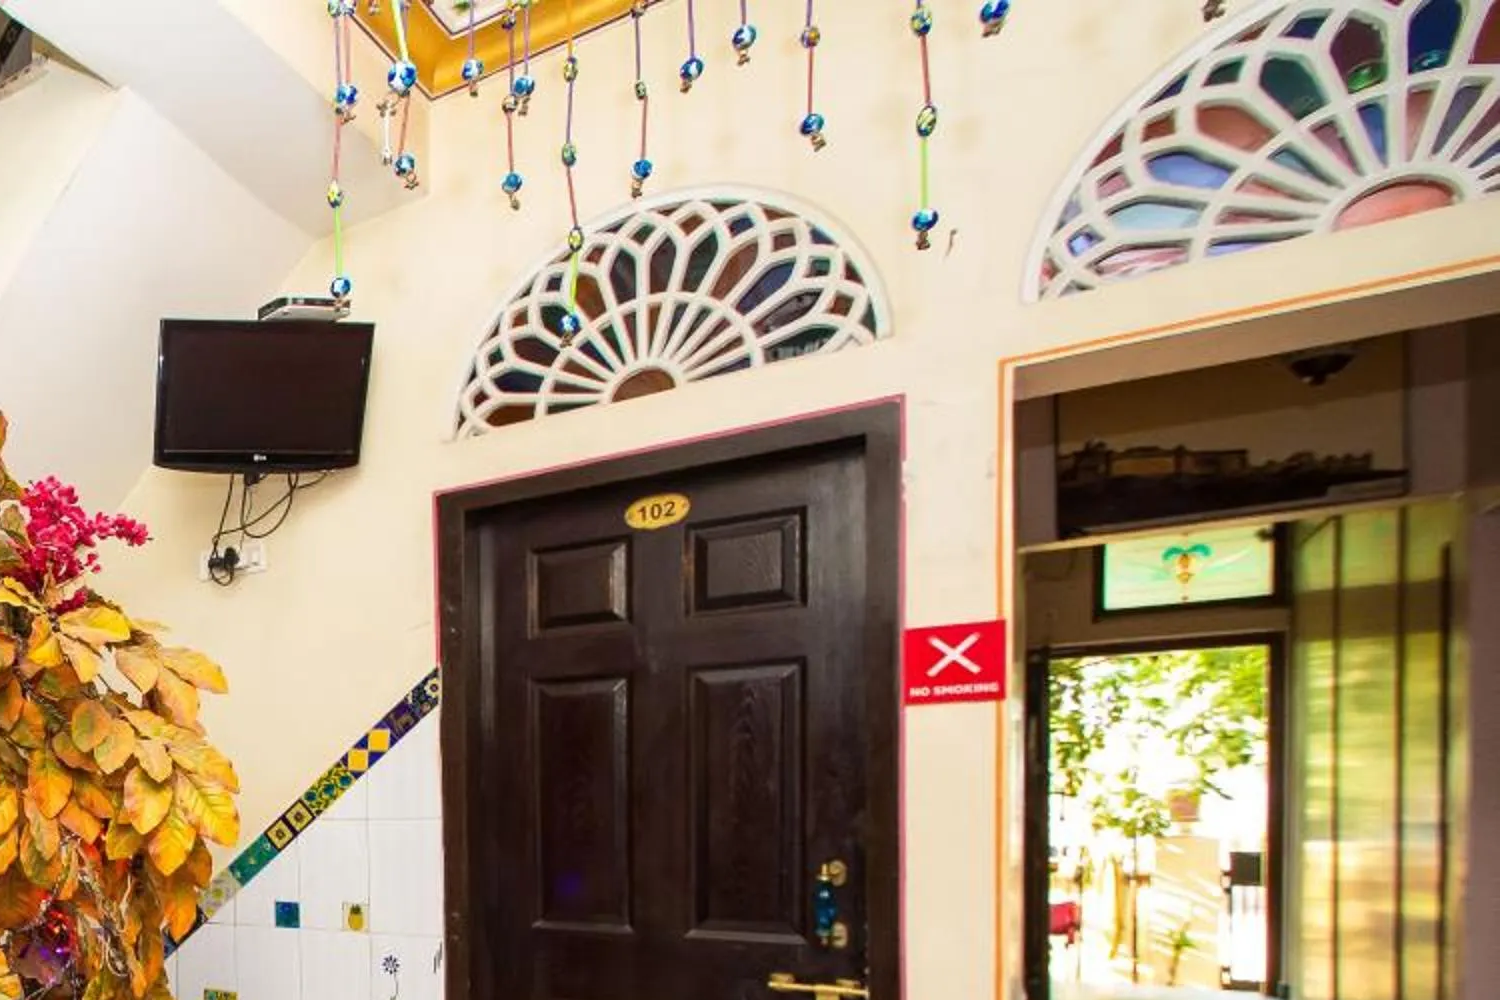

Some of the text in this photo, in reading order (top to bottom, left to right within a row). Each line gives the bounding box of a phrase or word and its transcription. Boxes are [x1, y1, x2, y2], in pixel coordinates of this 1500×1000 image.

[636, 501, 676, 522] 102
[909, 682, 999, 697] NO SMOKING
